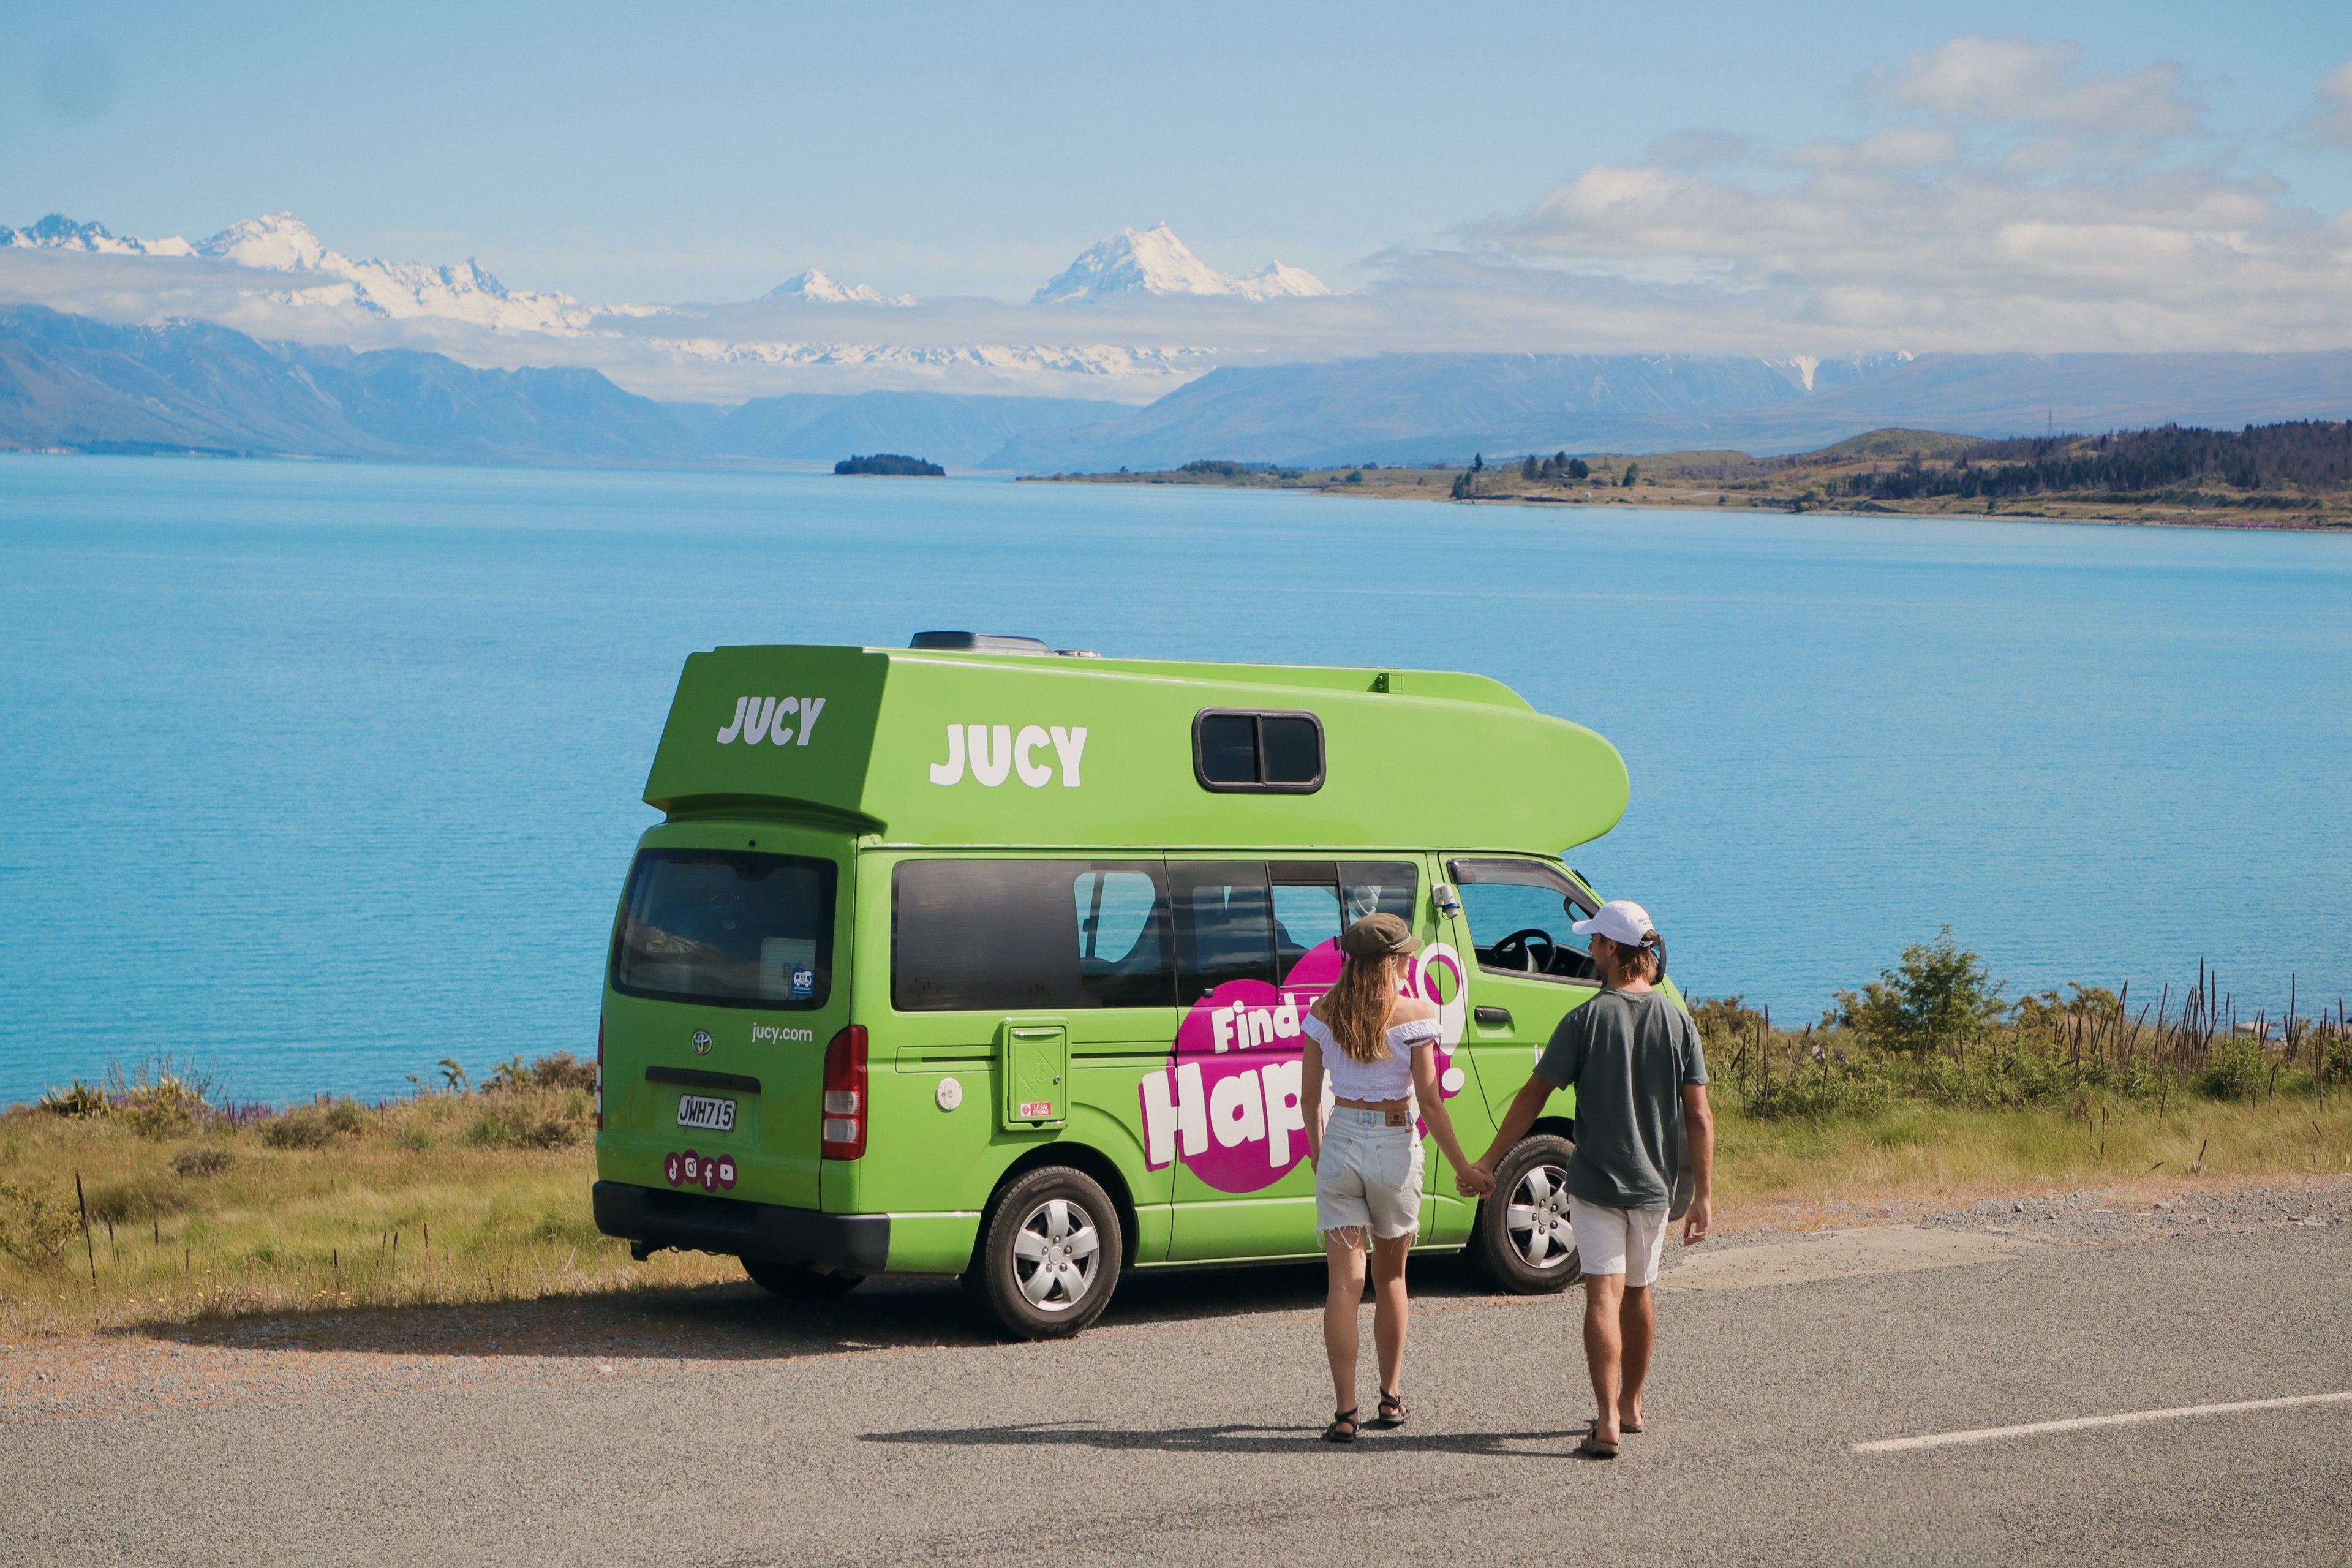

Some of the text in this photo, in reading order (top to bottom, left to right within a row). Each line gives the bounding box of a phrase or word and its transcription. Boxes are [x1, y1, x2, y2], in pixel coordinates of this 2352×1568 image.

[716, 696, 826, 746] JUCY
[929, 723, 1088, 788] JUCY
[752, 1022, 812, 1044] jucy.com
[1210, 992, 1301, 1054] Find
[1029, 1063, 1046, 1071] LPG
[1029, 1075, 1046, 1084] GAS
[679, 1099, 733, 1126] JWH715
[1142, 1059, 1330, 1168] Hap
